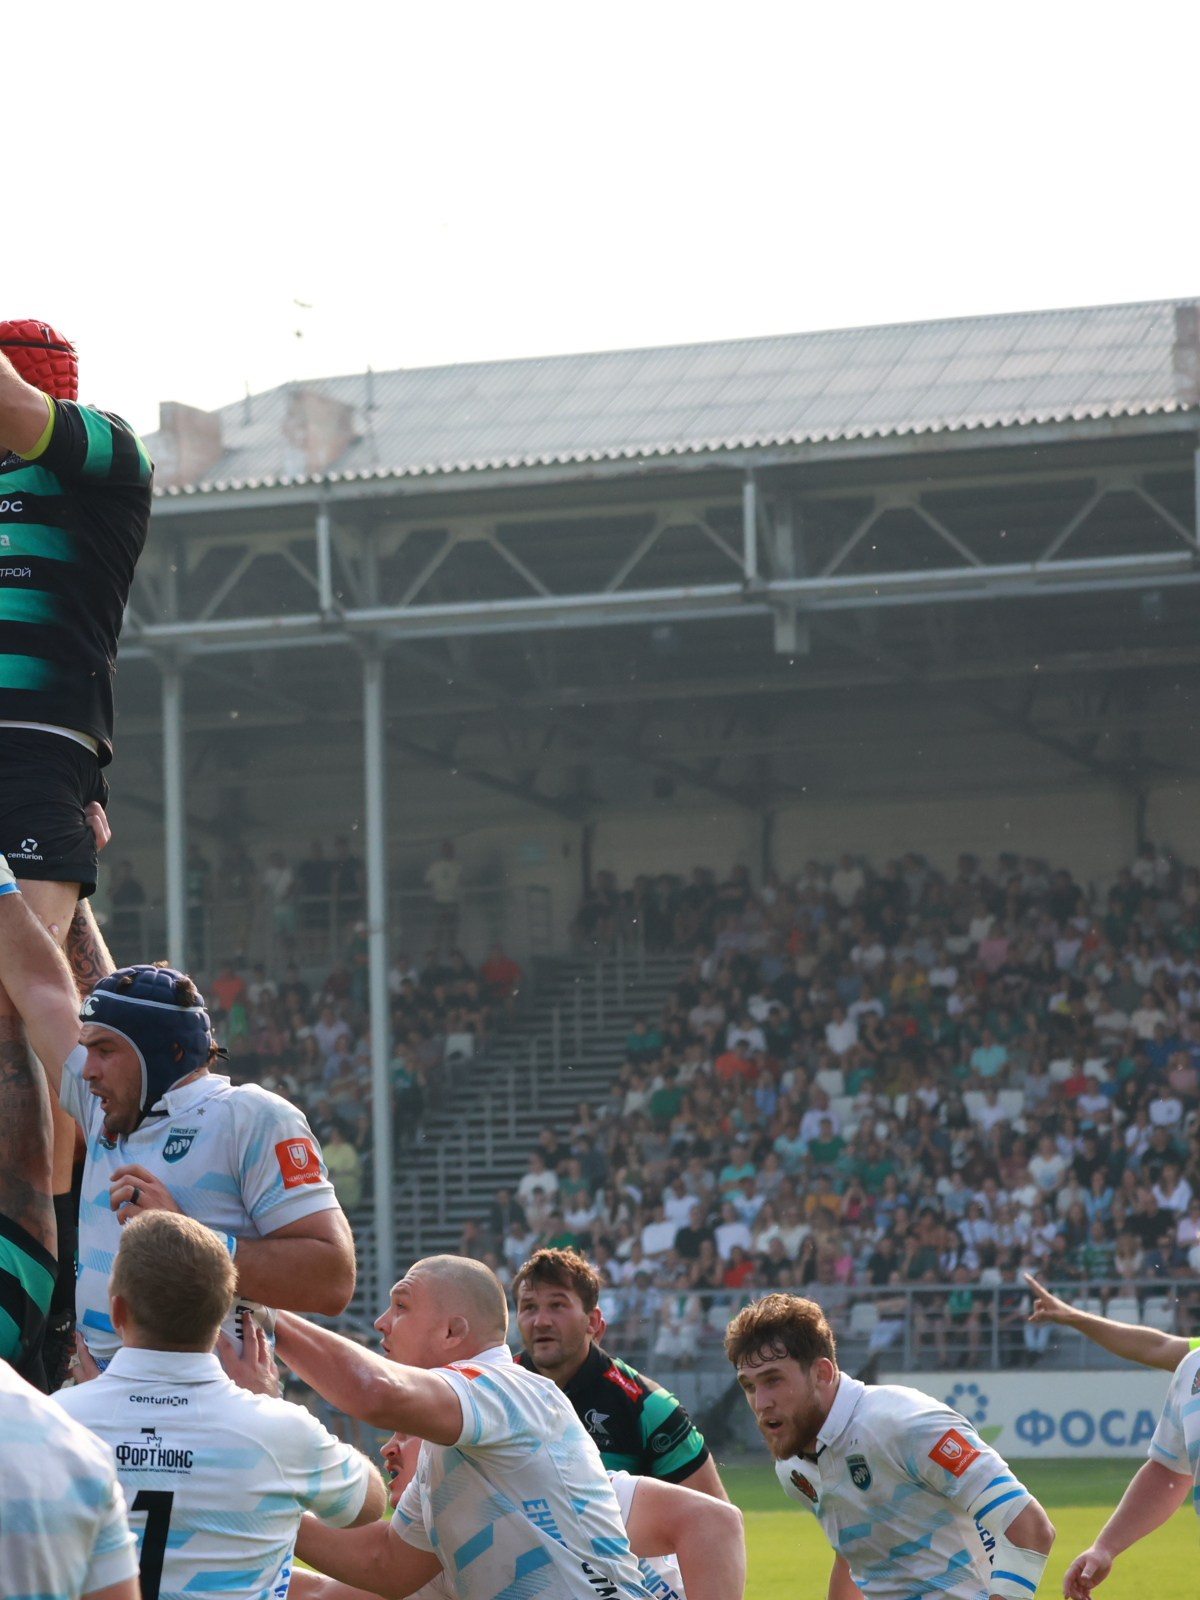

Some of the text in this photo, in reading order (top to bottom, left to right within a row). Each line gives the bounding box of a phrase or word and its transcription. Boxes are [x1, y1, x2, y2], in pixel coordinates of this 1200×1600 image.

[7, 851, 43, 861] centurion
[129, 1394, 188, 1407] centurion
[1015, 1409, 1156, 1447] ФОСА
[131, 1490, 174, 1600] 1
